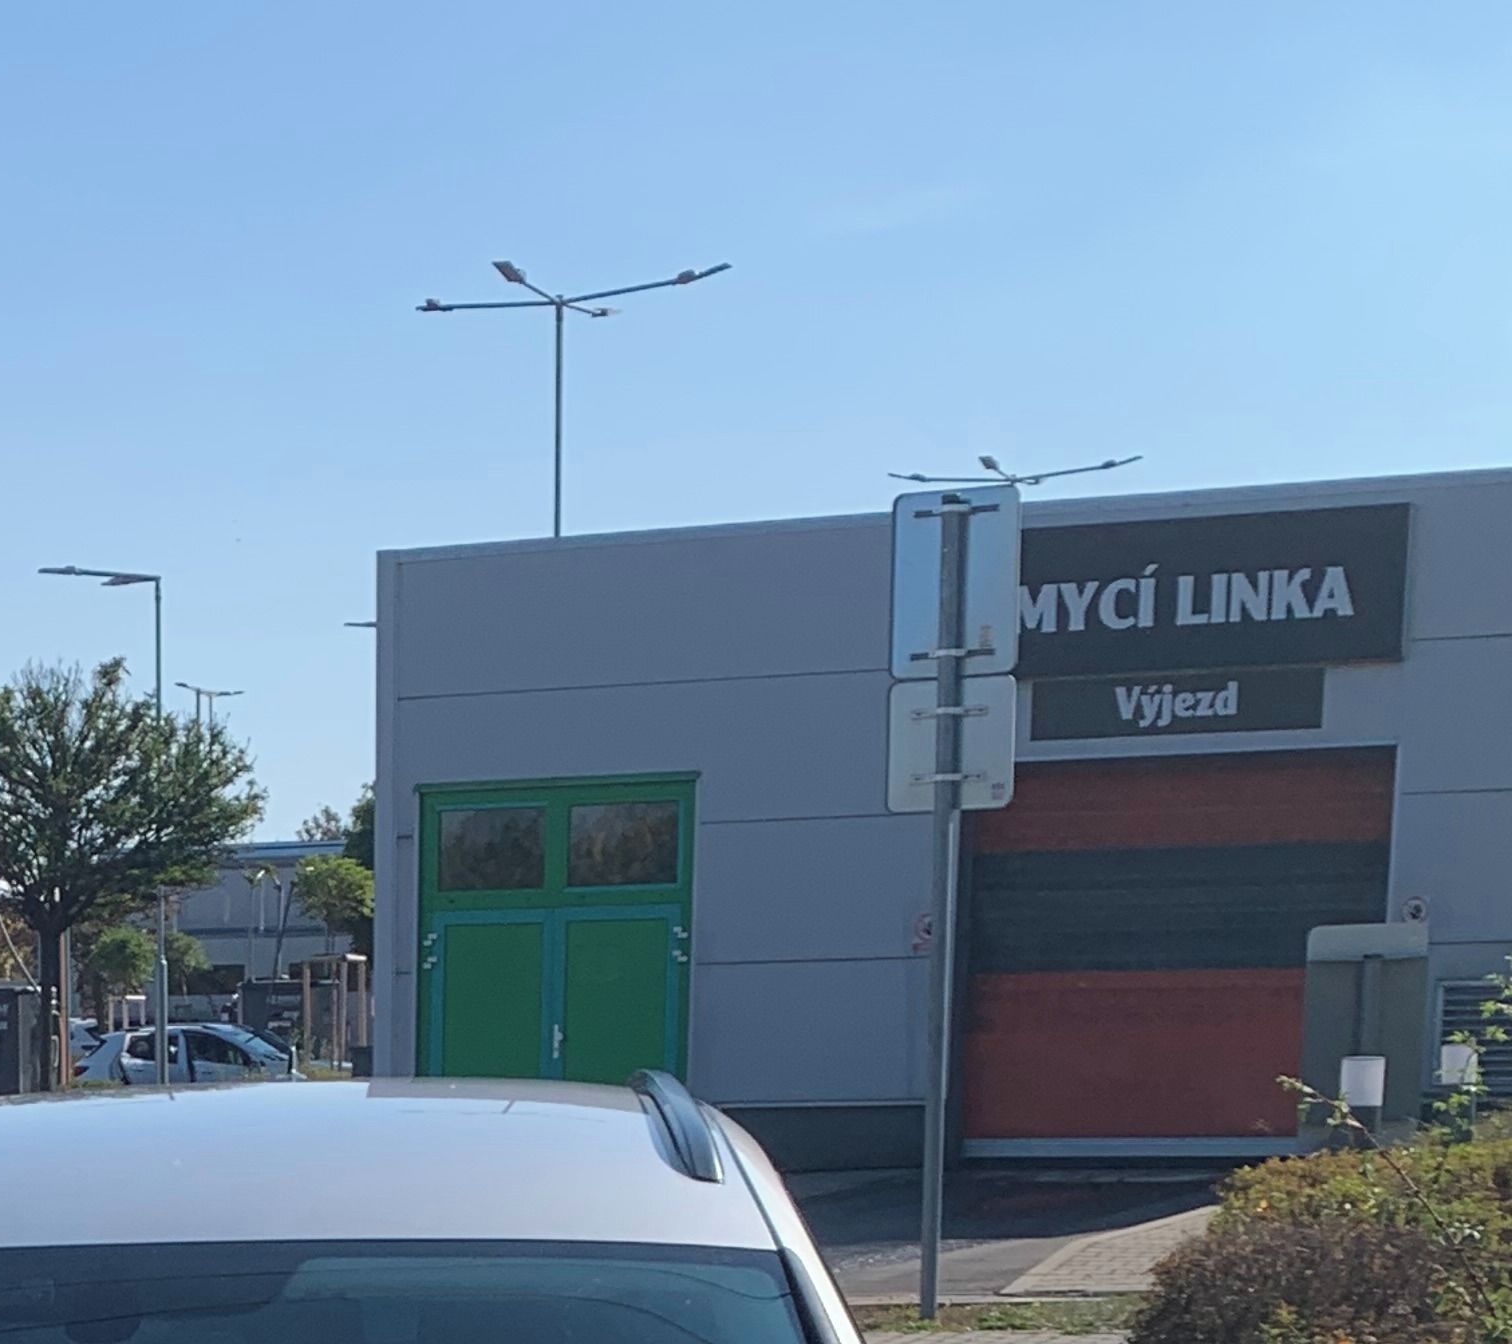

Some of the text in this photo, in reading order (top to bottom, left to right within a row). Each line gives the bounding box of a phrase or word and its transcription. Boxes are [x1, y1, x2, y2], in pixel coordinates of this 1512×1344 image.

[1019, 563, 1355, 633] MYCÍ LINKA
[1114, 681, 1239, 728] Výjezd
